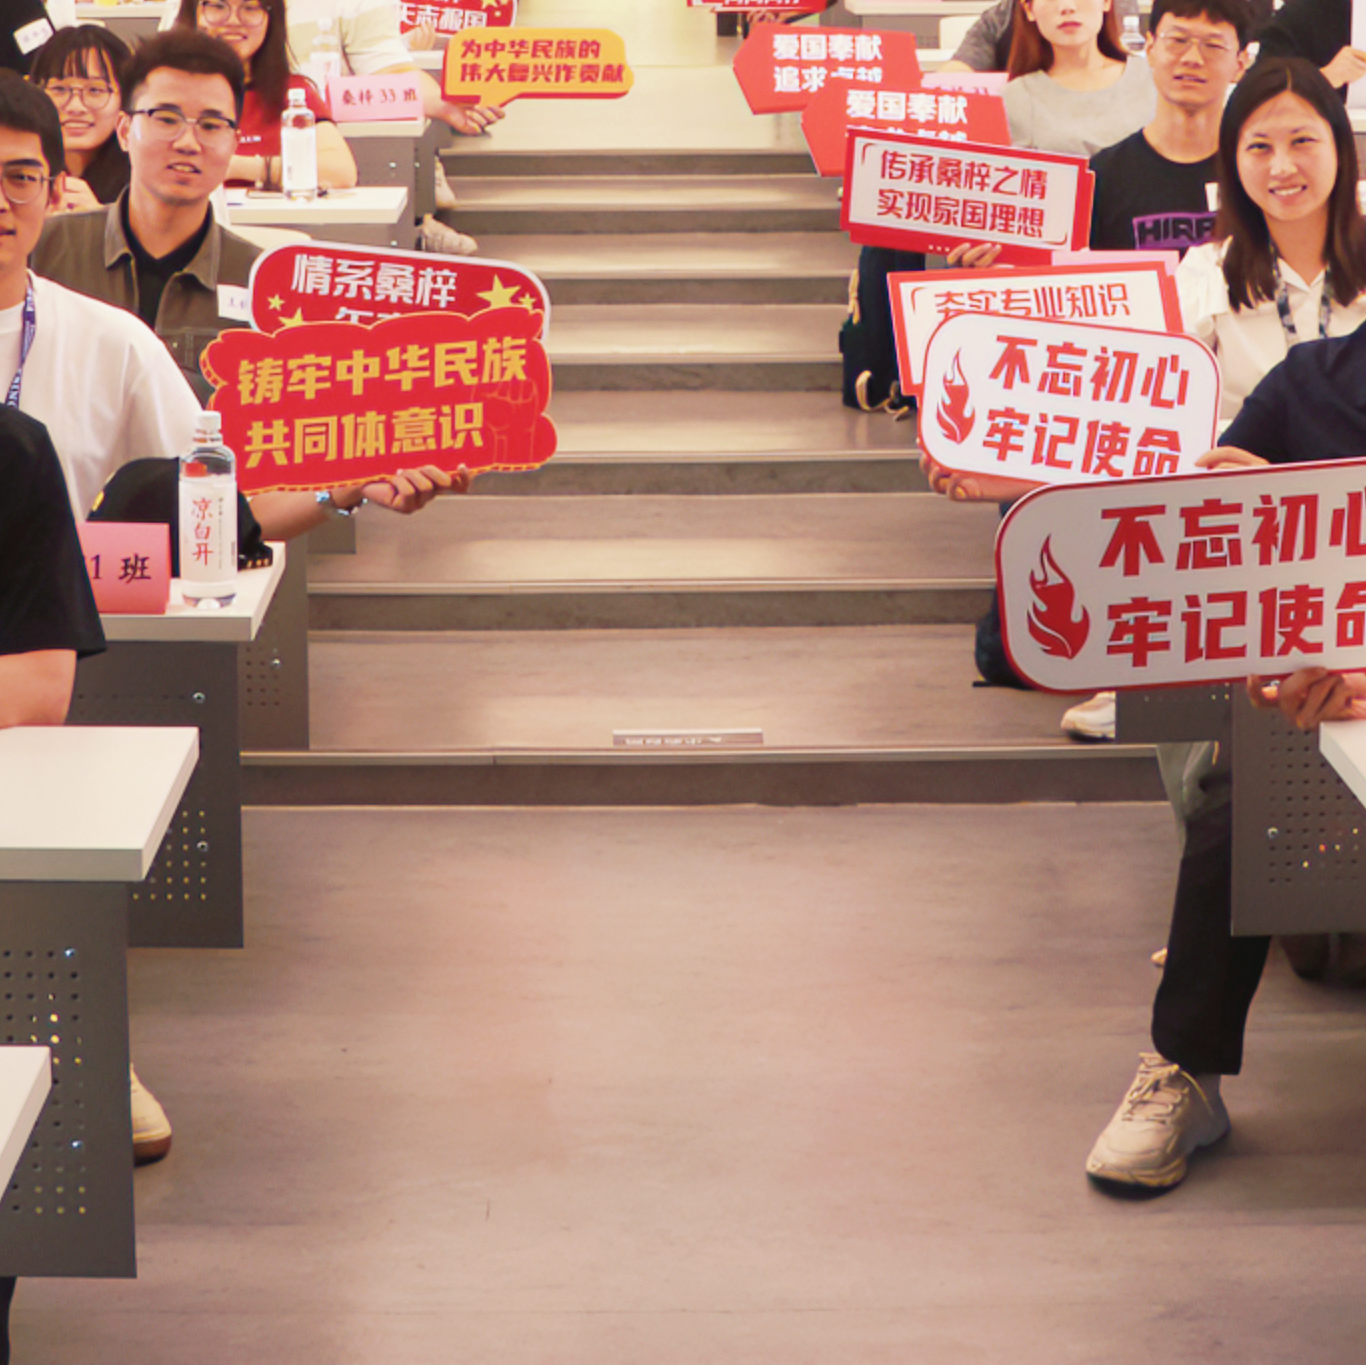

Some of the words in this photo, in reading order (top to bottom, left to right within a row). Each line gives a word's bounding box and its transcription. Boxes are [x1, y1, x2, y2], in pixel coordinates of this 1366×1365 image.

[460, 39, 601, 59] 为中华民族的
[773, 34, 882, 61] 爱国奉献
[342, 89, 372, 105] 桑梓
[380, 89, 395, 102] 33
[403, 88, 417, 102] 班
[460, 63, 624, 83] 伟大复兴作贡献
[846, 90, 967, 124] 爱国奉献
[880, 150, 1048, 200] 传承桑梓之情
[877, 189, 1044, 238] 实现家国理想
[292, 254, 457, 308] 情系桑梓
[935, 283, 1130, 319] 夯实专业知识
[237, 336, 527, 405] 铸牢中华民族
[989, 335, 1189, 410] 不忘初心
[245, 402, 484, 468] 共同体意识
[982, 406, 1182, 476] 牢记使命
[191, 497, 213, 566] 凉白开
[118, 552, 151, 584] 班
